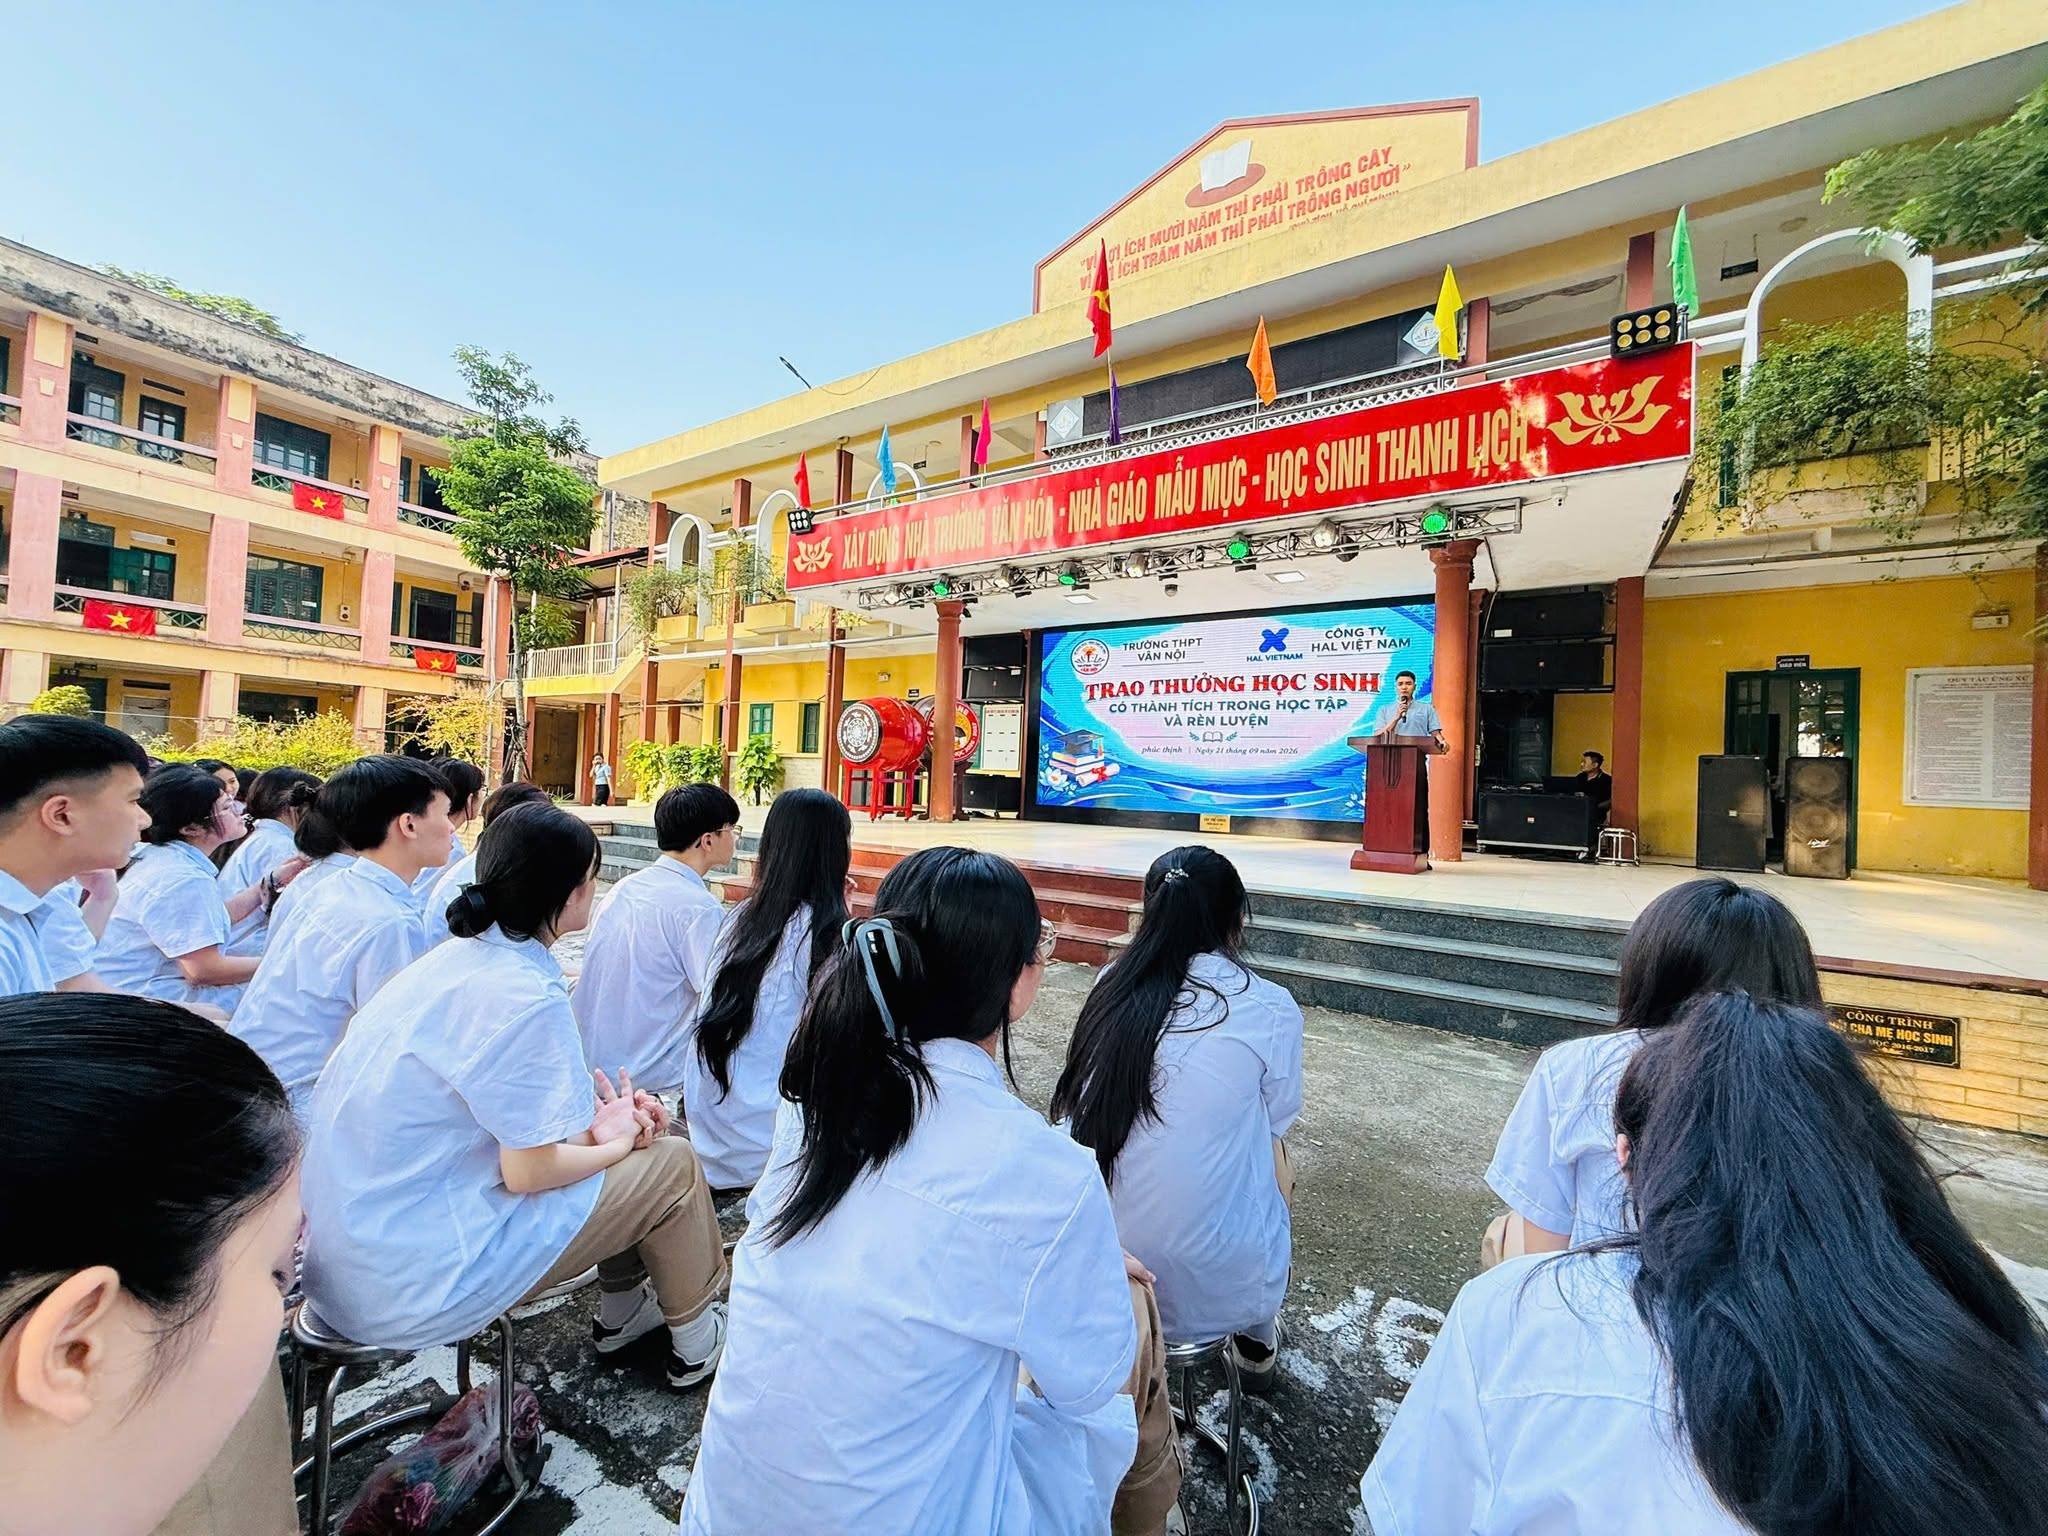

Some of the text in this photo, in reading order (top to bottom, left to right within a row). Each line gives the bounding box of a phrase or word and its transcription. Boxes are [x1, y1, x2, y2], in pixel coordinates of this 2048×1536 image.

[1188, 211, 1221, 234] NĂM
[1184, 231, 1216, 256] NĂM
[842, 526, 865, 570] XÂY
[868, 523, 899, 571] DỰNG
[905, 512, 930, 560] NHÀ
[934, 501, 985, 556] TRƯỜNG
[991, 497, 1020, 545] VĂN
[1024, 489, 1054, 540] HÓA
[1068, 478, 1101, 533] NHÀ
[1106, 471, 1148, 527] GIÁO
[1154, 455, 1197, 520] MẪU
[1202, 455, 1247, 518] MỰC
[1265, 447, 1308, 508] HỌC
[1314, 434, 1370, 494] SINH
[1376, 417, 1460, 483] THANH
[1466, 408, 1529, 478] LỊCH
[1325, 626, 1387, 639] CÔNG TY
[1122, 637, 1203, 651] TRƯỜNG THPT
[1311, 637, 1411, 652] HAL VIỆT NAM
[1137, 649, 1186, 662] VÂN NỘI
[1266, 653, 1303, 662] VIETNAM
[1085, 672, 1381, 701] TRAO THƯỞNG HỌC SINH
[1109, 696, 1348, 713] CÓ THÀNH TÍCH TRONG HỌC TẬP
[1164, 714, 1269, 729] VÀ RÈN LUYỆN
[1846, 1010, 1933, 1029] CÔNG TRÌNH
[1850, 1023, 1873, 1036] CHA
[1875, 1026, 1894, 1041] MẸ
[1896, 1029, 1920, 1043] HỌC
[1923, 1032, 1953, 1047] SINH
